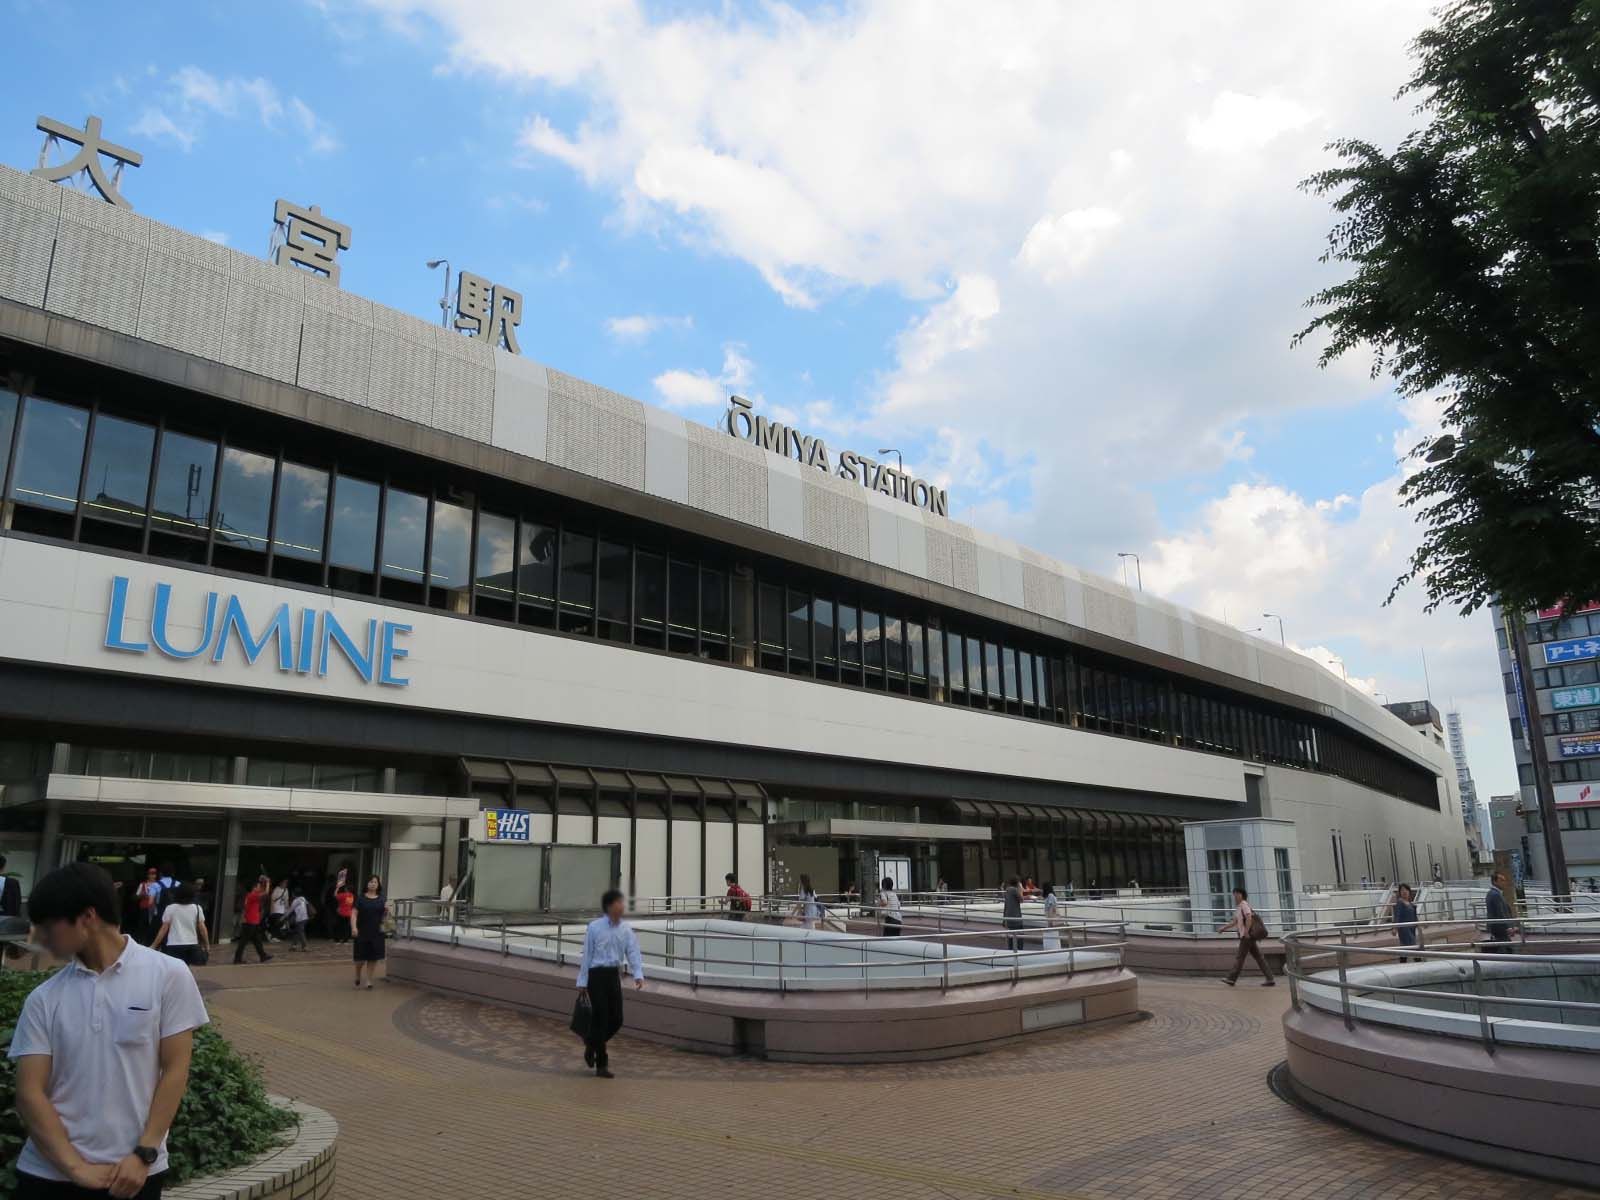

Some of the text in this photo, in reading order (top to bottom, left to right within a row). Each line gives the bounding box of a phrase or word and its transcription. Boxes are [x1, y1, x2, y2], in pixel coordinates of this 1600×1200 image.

[30, 114, 523, 355] 大宮駅
[728, 395, 948, 517] ŌMIYA STATION
[104, 575, 414, 686] LUMINE
[497, 812, 529, 833] HIS
